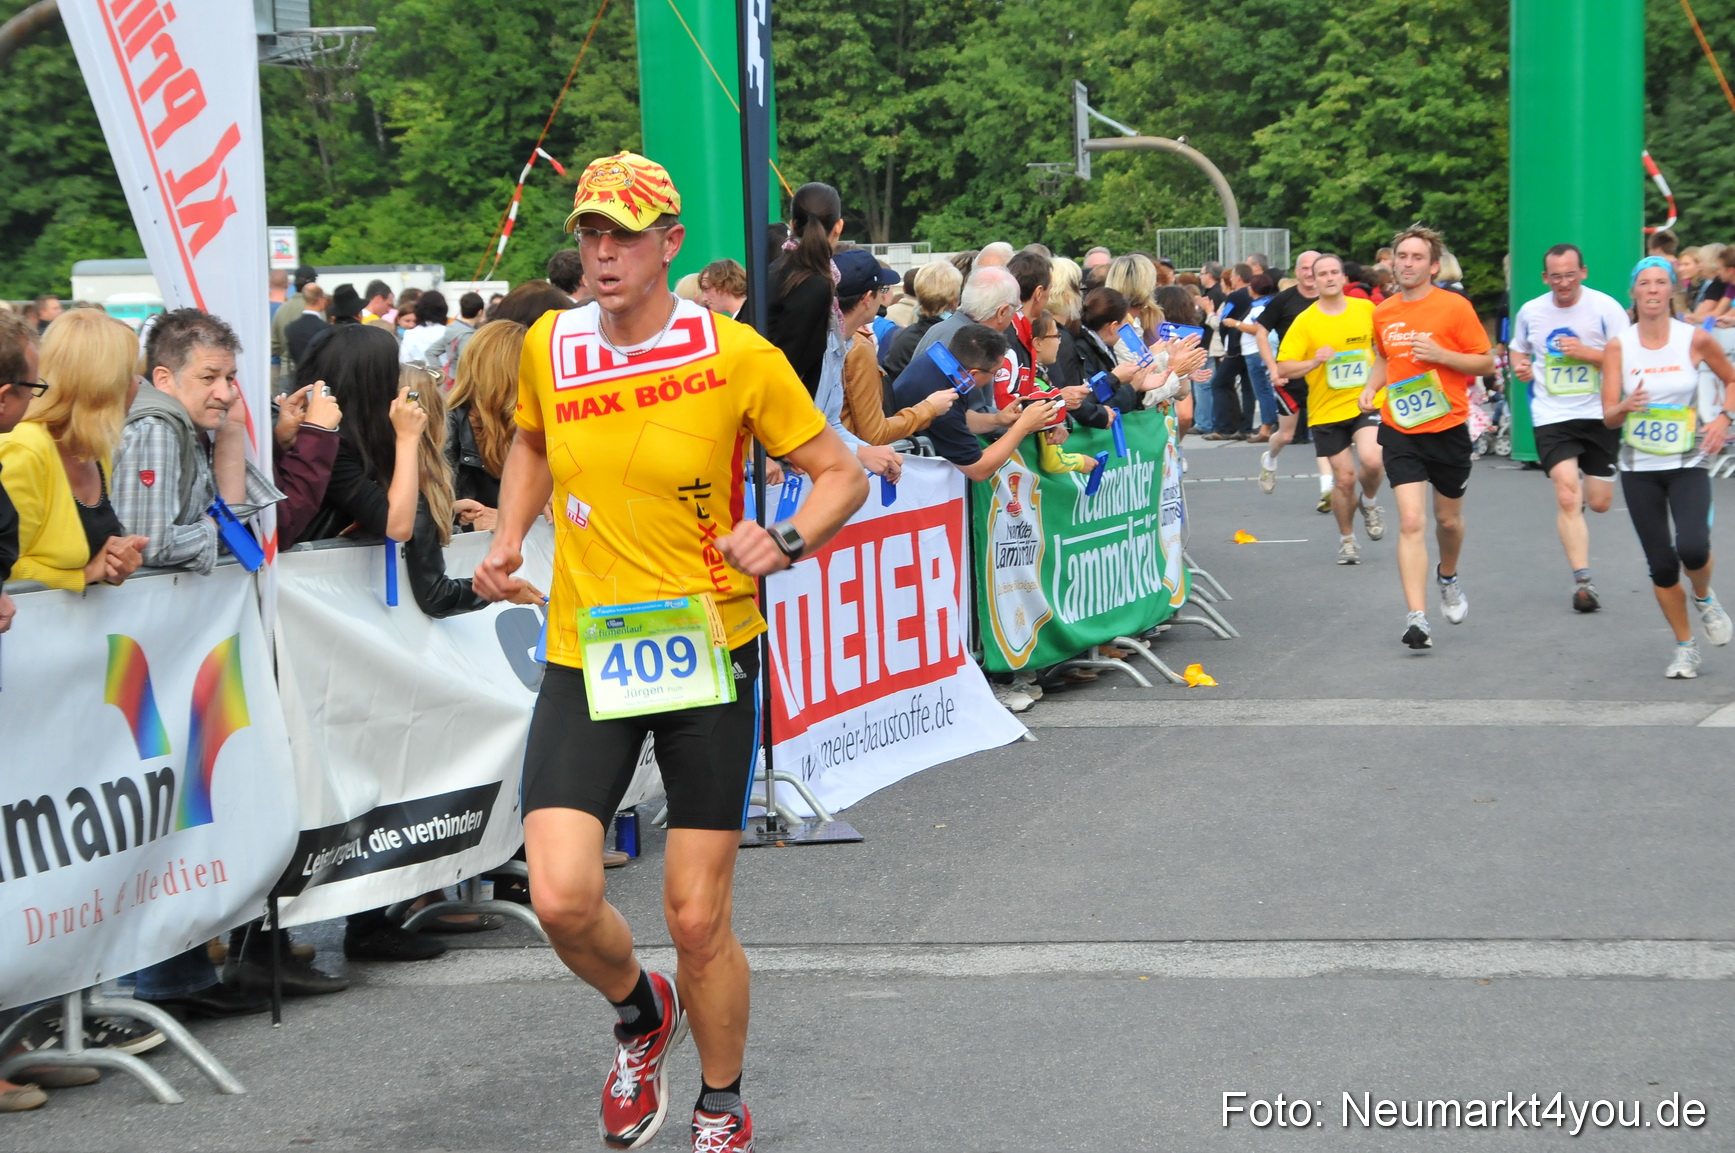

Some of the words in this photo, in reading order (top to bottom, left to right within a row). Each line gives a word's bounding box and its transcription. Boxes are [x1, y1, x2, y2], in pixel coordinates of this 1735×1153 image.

[1332, 363, 1363, 380] 174
[1551, 366, 1589, 384] 712
[555, 391, 625, 424] MAX
[635, 368, 727, 408] BÖGL
[1395, 389, 1436, 417] 992
[1633, 420, 1679, 443] 488
[1053, 516, 1163, 624] Lammsbräu
[766, 524, 960, 721] MEIER
[600, 635, 698, 687] 409
[624, 685, 664, 700] Jürgen
[0, 766, 176, 884] mann
[368, 827, 403, 854] die
[402, 809, 484, 847] verbinden
[23, 888, 104, 946] Druck
[130, 858, 229, 909] Medien
